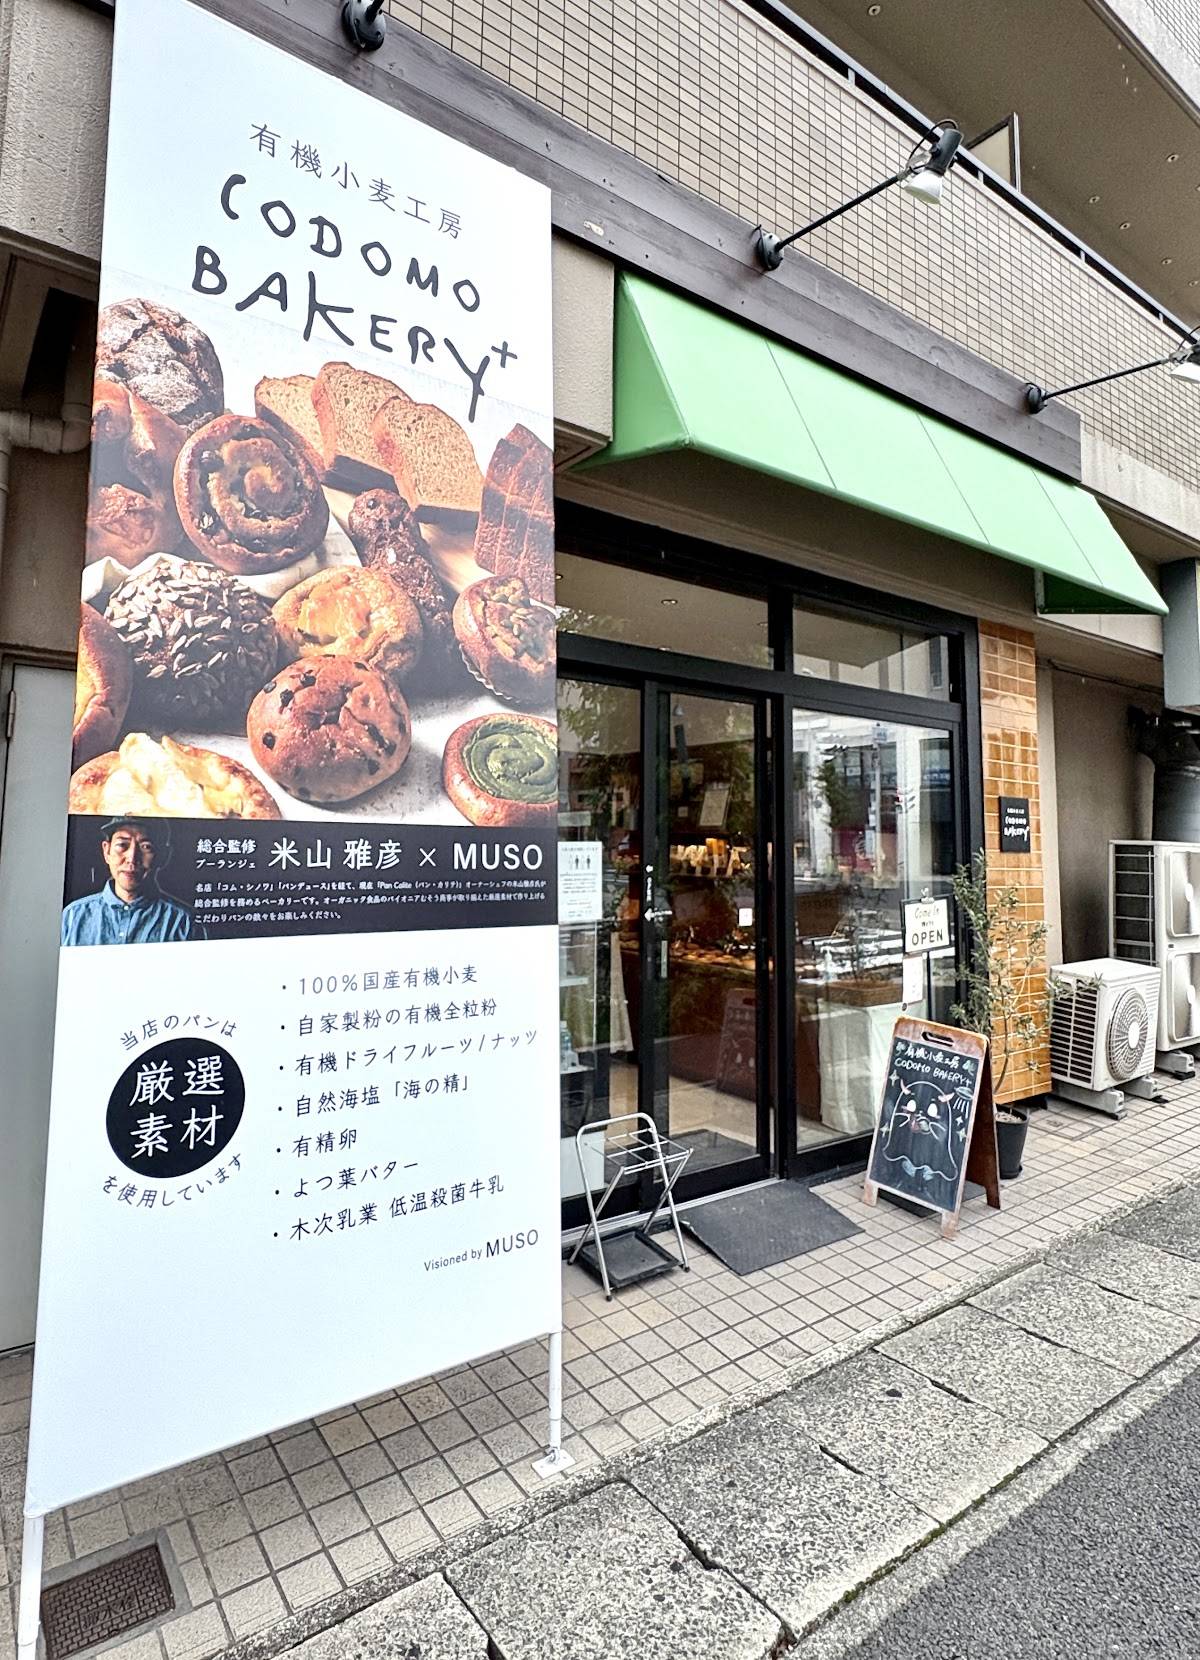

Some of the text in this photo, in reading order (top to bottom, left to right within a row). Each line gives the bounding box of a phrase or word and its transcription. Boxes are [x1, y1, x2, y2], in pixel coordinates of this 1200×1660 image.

[249, 123, 463, 239] 有機小麦工房
[221, 174, 481, 313] CODOMO
[195, 858, 256, 870] ブーランジェ
[196, 838, 257, 855] 総合監修
[453, 842, 543, 870] MUSO
[911, 928, 943, 946] OPEN
[299, 964, 478, 996] 100%国産有機小麦
[120, 1014, 237, 1051] 当店のパンは
[299, 998, 497, 1037] 自家製粉の有機全粒粉
[129, 1055, 225, 1107] 厳選
[130, 1104, 224, 1159] 素材
[292, 1128, 358, 1158] 有精卵
[103, 1153, 241, 1209] を使用しています
[293, 1161, 418, 1198] よつ葉バター
[290, 1175, 505, 1241] 木次乳業 低温殺菌牛乳
[424, 1229, 539, 1272] Visioned by MUSO
